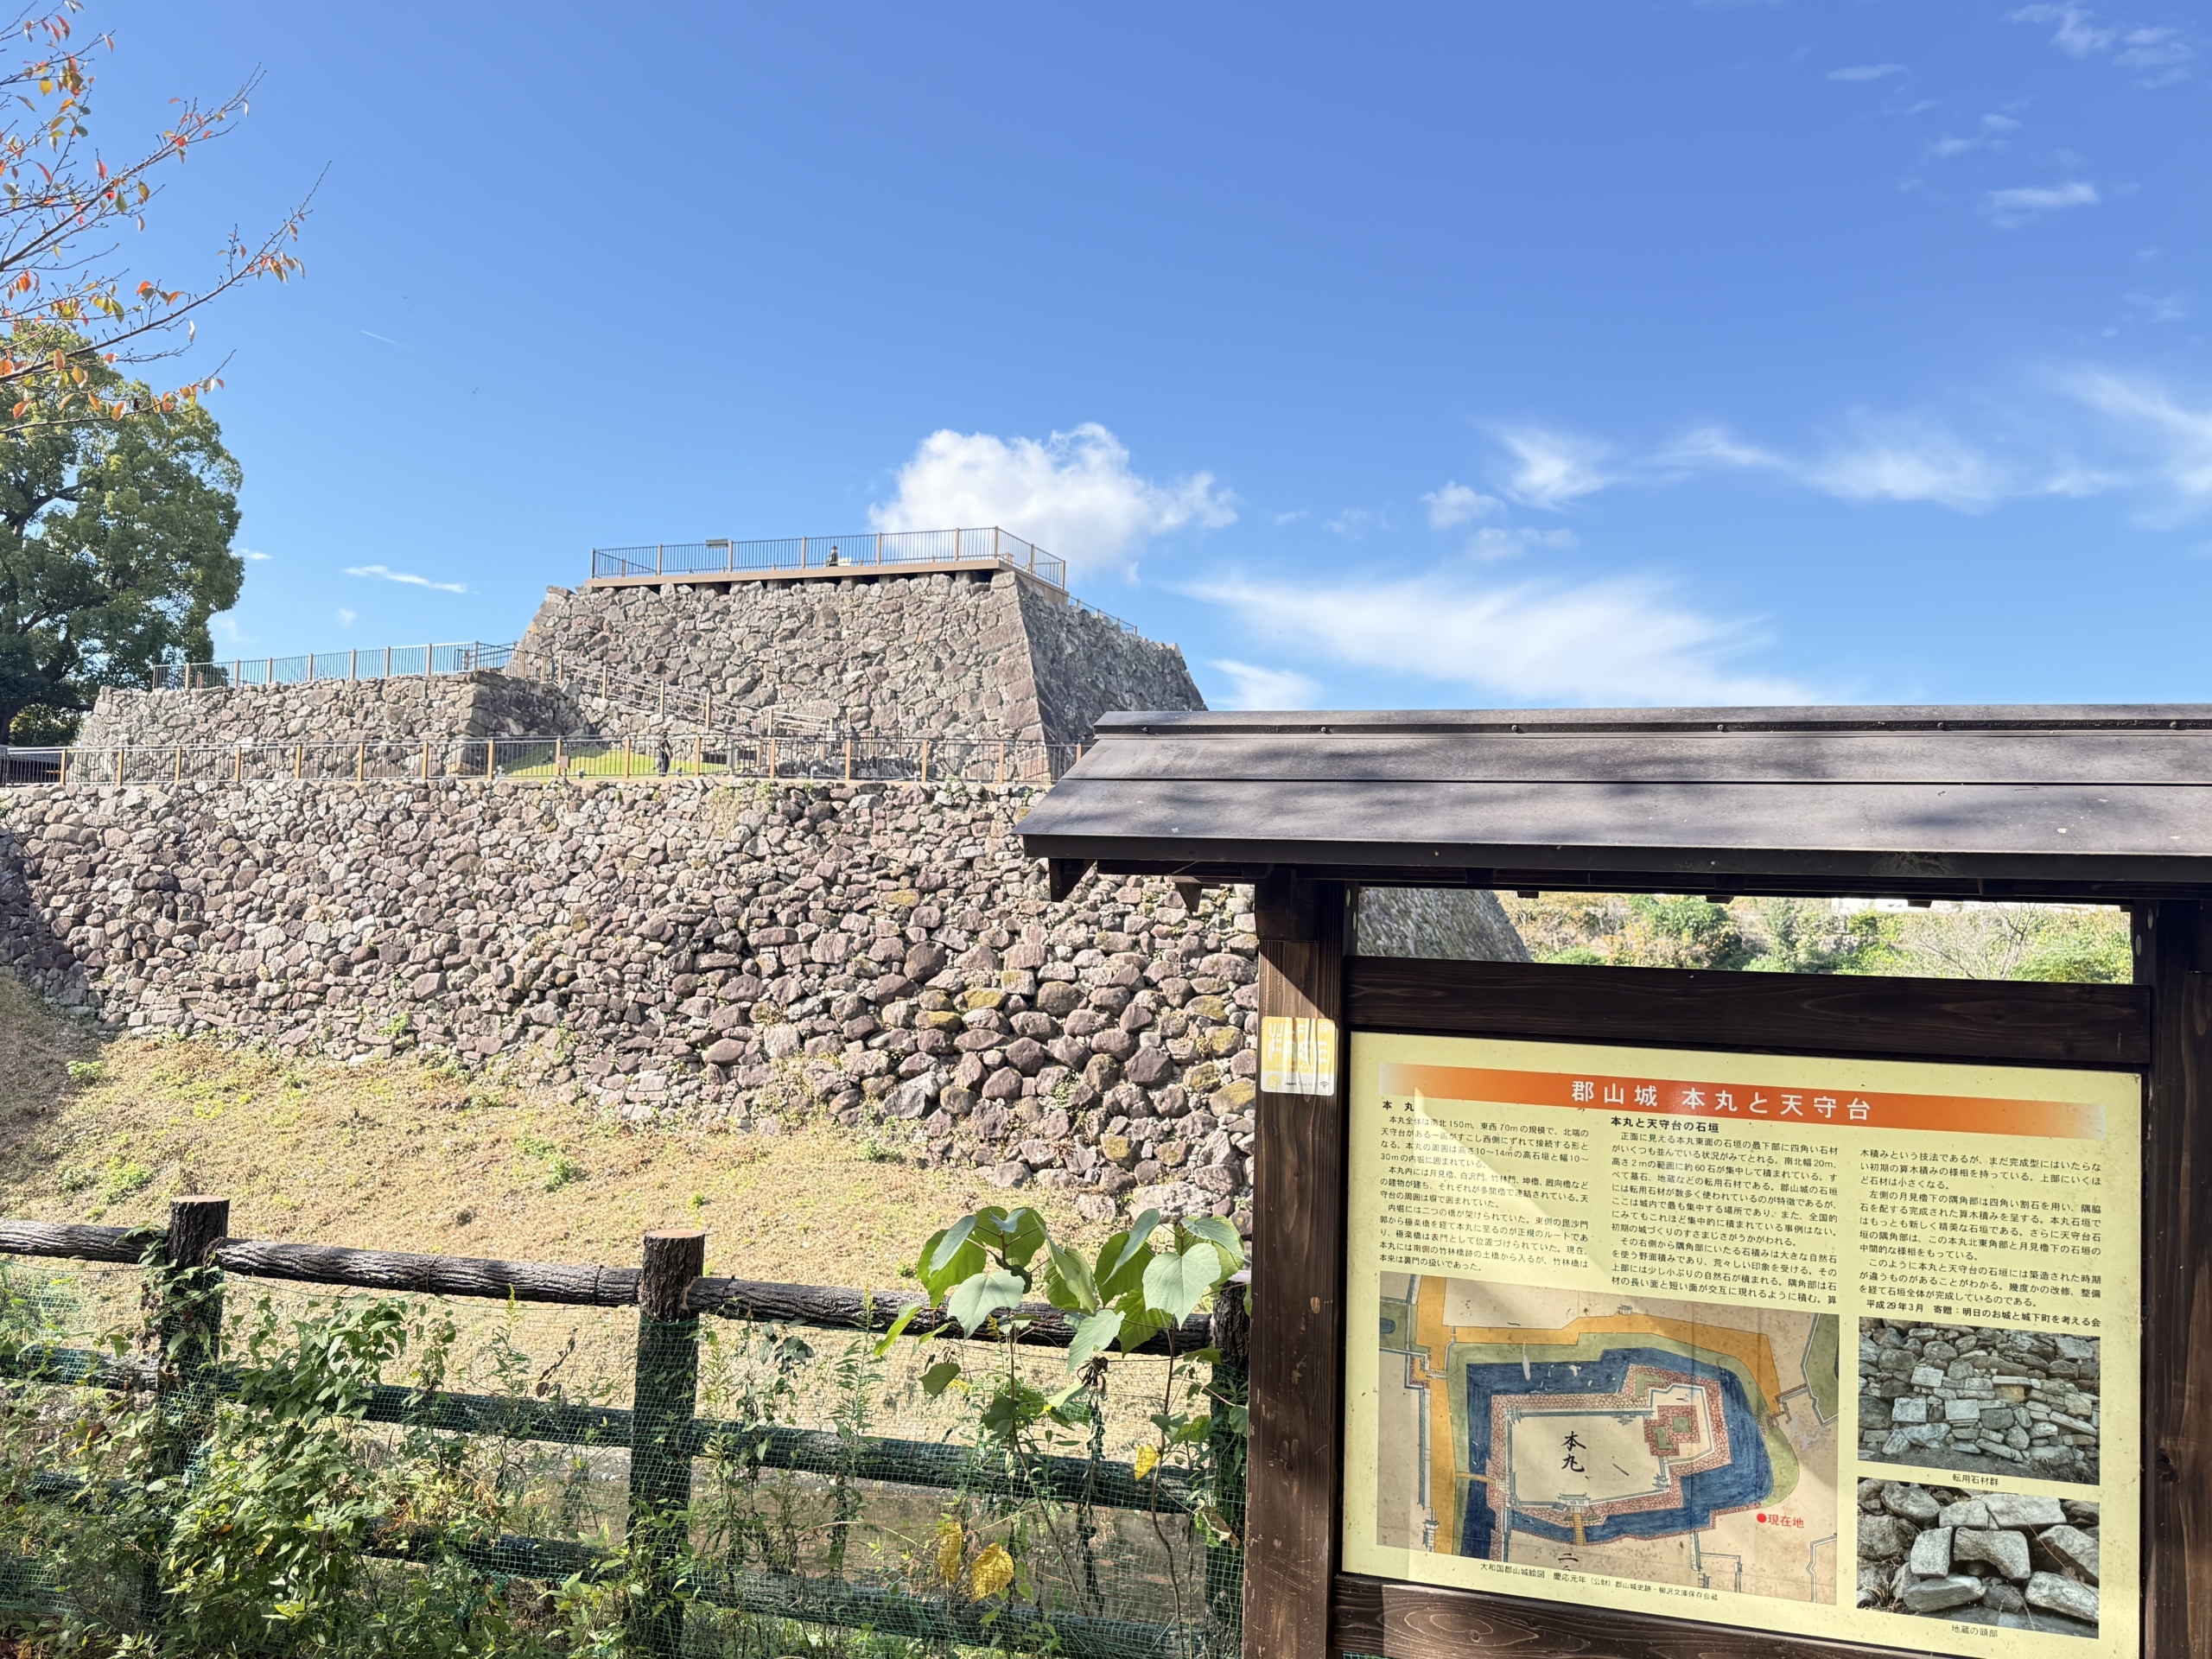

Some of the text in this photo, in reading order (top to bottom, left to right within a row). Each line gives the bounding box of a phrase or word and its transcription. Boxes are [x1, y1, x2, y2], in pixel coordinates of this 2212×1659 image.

[1571, 1080, 1871, 1121] 郡山城 本丸と天守台
[1611, 1116, 1719, 1133] 本丸と天守台の石垣
[1860, 1176, 1949, 1190] ど石材は小さくなる。
[1859, 1244, 1978, 1262] 中間的な様相をもっている。
[1953, 1473, 1999, 1486] 転用石材群
[1767, 1514, 1804, 1529] 現在地
[1480, 1562, 1545, 1579] 大和国郡山城絵図
[1952, 1624, 1998, 1637] 地蔵の頭部
